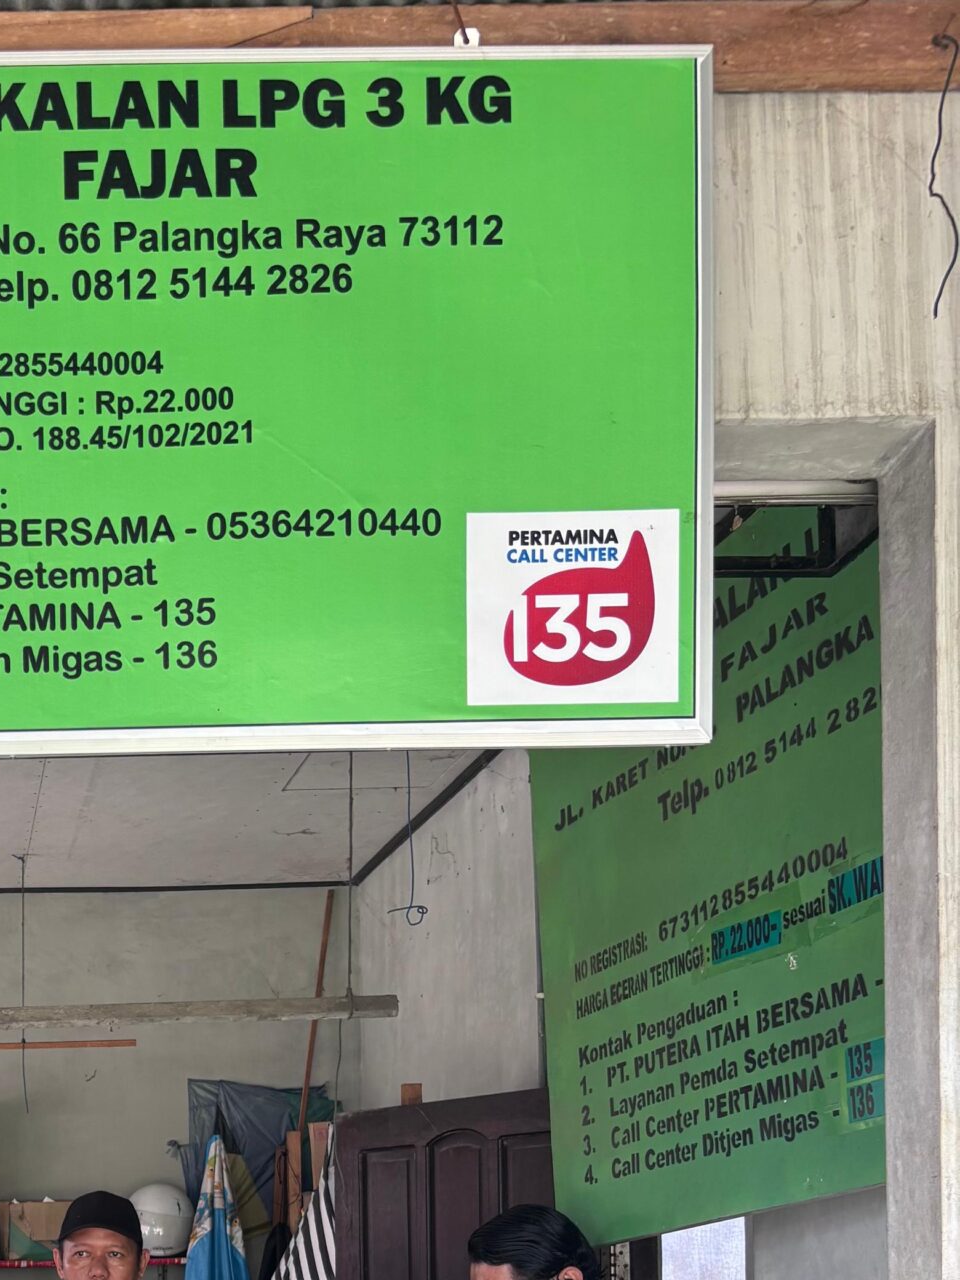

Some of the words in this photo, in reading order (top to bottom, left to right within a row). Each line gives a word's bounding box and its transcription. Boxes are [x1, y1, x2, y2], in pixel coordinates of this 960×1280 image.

[222, 77, 346, 129] LPG
[366, 76, 404, 127] 3
[425, 75, 512, 125] KG
[63, 148, 257, 200] FAJAR
[58, 222, 100, 254] 66
[114, 218, 282, 259] Palangka
[296, 216, 386, 255] Raya
[398, 215, 504, 247] 73112
[71, 268, 157, 301] 0812
[169, 265, 255, 299] 5144
[266, 263, 353, 296] 2826
[95, 386, 234, 420] Rp.22.000
[32, 420, 254, 451] 188.45/102/2021
[206, 508, 442, 540] 05364210440
[508, 528, 619, 546] PERTAMINA
[506, 548, 548, 564] CALL
[553, 546, 619, 562] CENTER
[153, 597, 217, 628] 135
[512, 592, 632, 663] 135
[720, 591, 830, 684] FAJAR
[22, 644, 123, 680] Migas
[154, 639, 218, 670] 136
[736, 614, 875, 724] PALANGKA
[657, 777, 710, 822] Telp.
[714, 751, 758, 791] 0812
[765, 716, 817, 764] 5144
[826, 685, 881, 736] 282
[591, 757, 649, 810] KARET
[574, 957, 588, 983] NO
[658, 837, 849, 943] 673112855440004
[576, 985, 610, 1020] HARGA
[610, 973, 649, 1005] ECERAN
[783, 888, 826, 930] sesuai
[578, 1030, 632, 1069] Kontak
[637, 993, 727, 1045] Pengaduan
[579, 1075, 593, 1097] 1.
[606, 1060, 630, 1088] PT.
[634, 1035, 701, 1077] PUTERA
[706, 1013, 750, 1052] ITAH
[756, 972, 868, 1035] BERSAMA
[581, 1104, 595, 1126] 2.
[609, 1081, 675, 1119] Layanan
[679, 1058, 738, 1096] Pemda
[744, 1018, 849, 1076] Setempat
[583, 1134, 596, 1157] 3.
[610, 1120, 640, 1150] Call
[645, 1106, 700, 1138] Center
[704, 1064, 825, 1122] PERTAMINA
[846, 1041, 873, 1079] 135
[584, 1164, 598, 1186] 4.
[611, 1153, 640, 1180] Call
[645, 1140, 698, 1172] Center
[702, 1122, 754, 1158] Ditjen
[758, 1109, 820, 1143] Migas
[849, 1083, 875, 1121] 136
